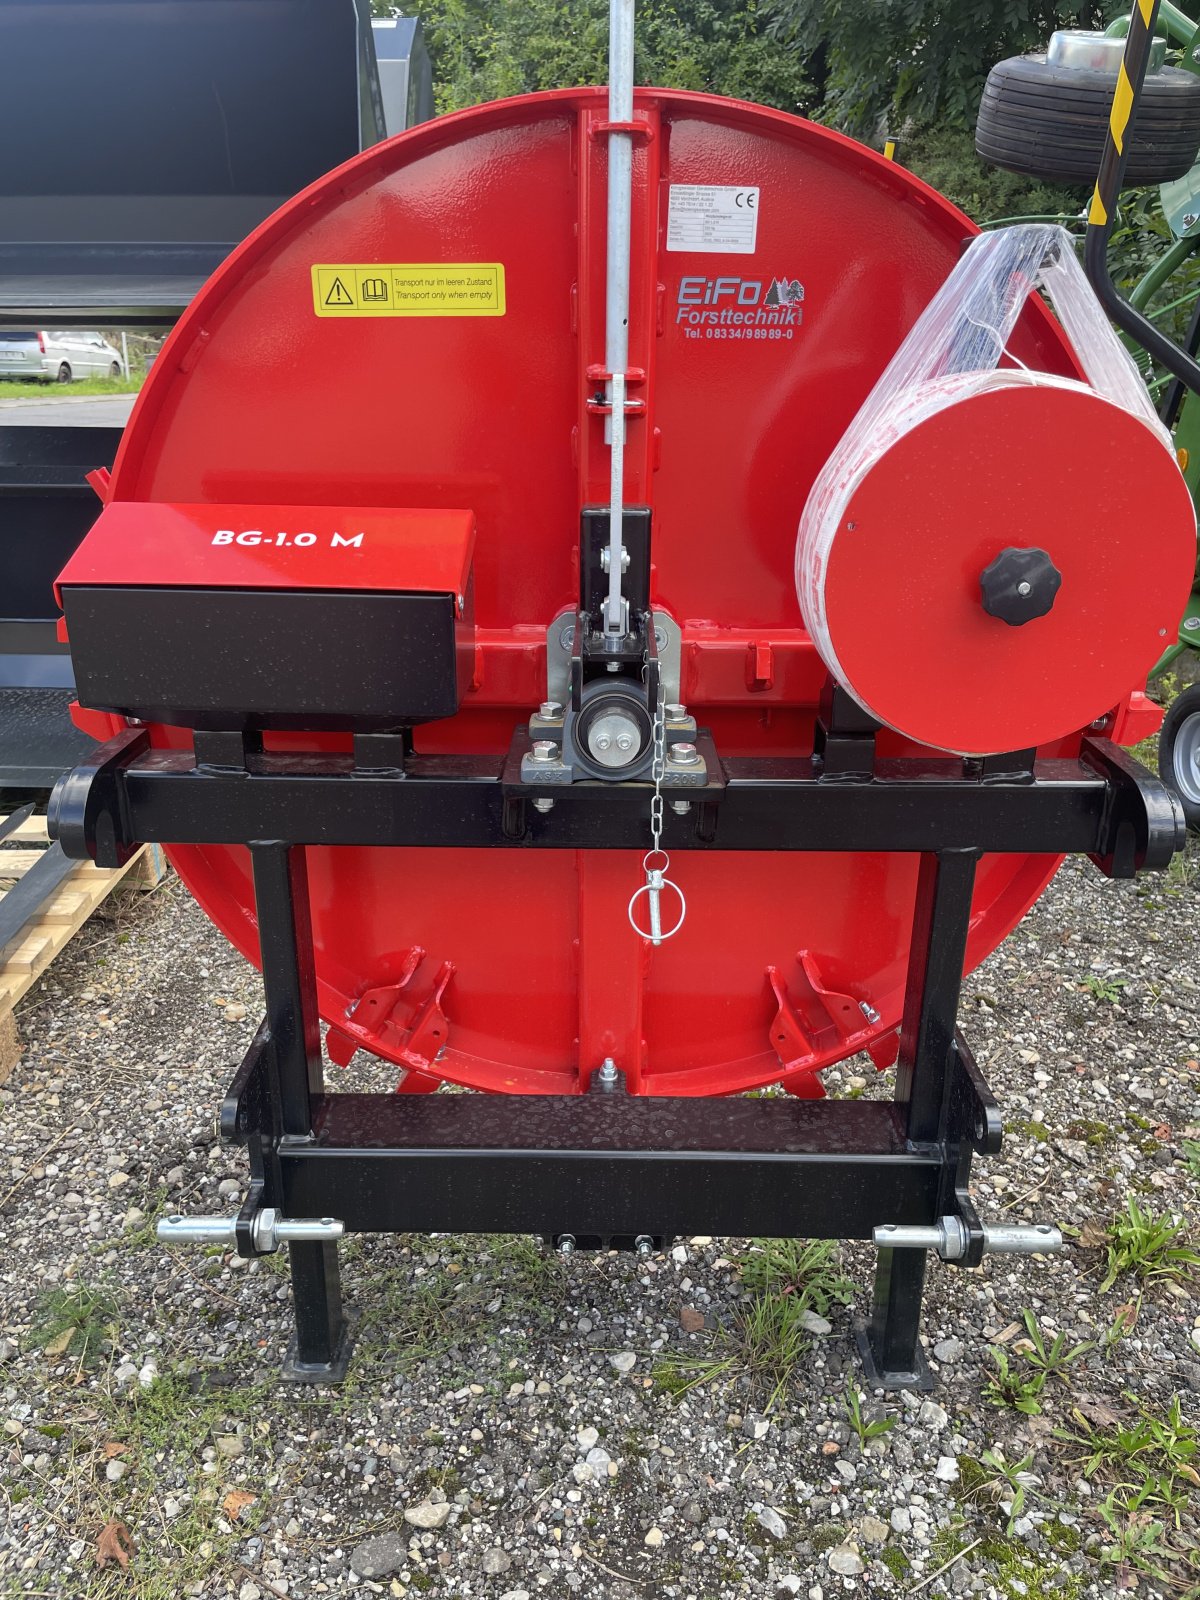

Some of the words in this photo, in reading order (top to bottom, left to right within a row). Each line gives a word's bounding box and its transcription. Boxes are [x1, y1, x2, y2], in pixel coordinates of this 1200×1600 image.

[394, 278, 424, 287] Transport
[446, 278, 465, 286] leeren
[466, 278, 493, 286] Zustand
[396, 291, 430, 300] Transport
[431, 291, 447, 300] only
[448, 291, 468, 299] when
[469, 291, 493, 300] empty
[677, 277, 762, 305] EiFo
[676, 306, 796, 325] Forsttechnik
[684, 328, 703, 339] Tel.
[211, 530, 318, 546] BG-1.0
[330, 531, 365, 548] M
